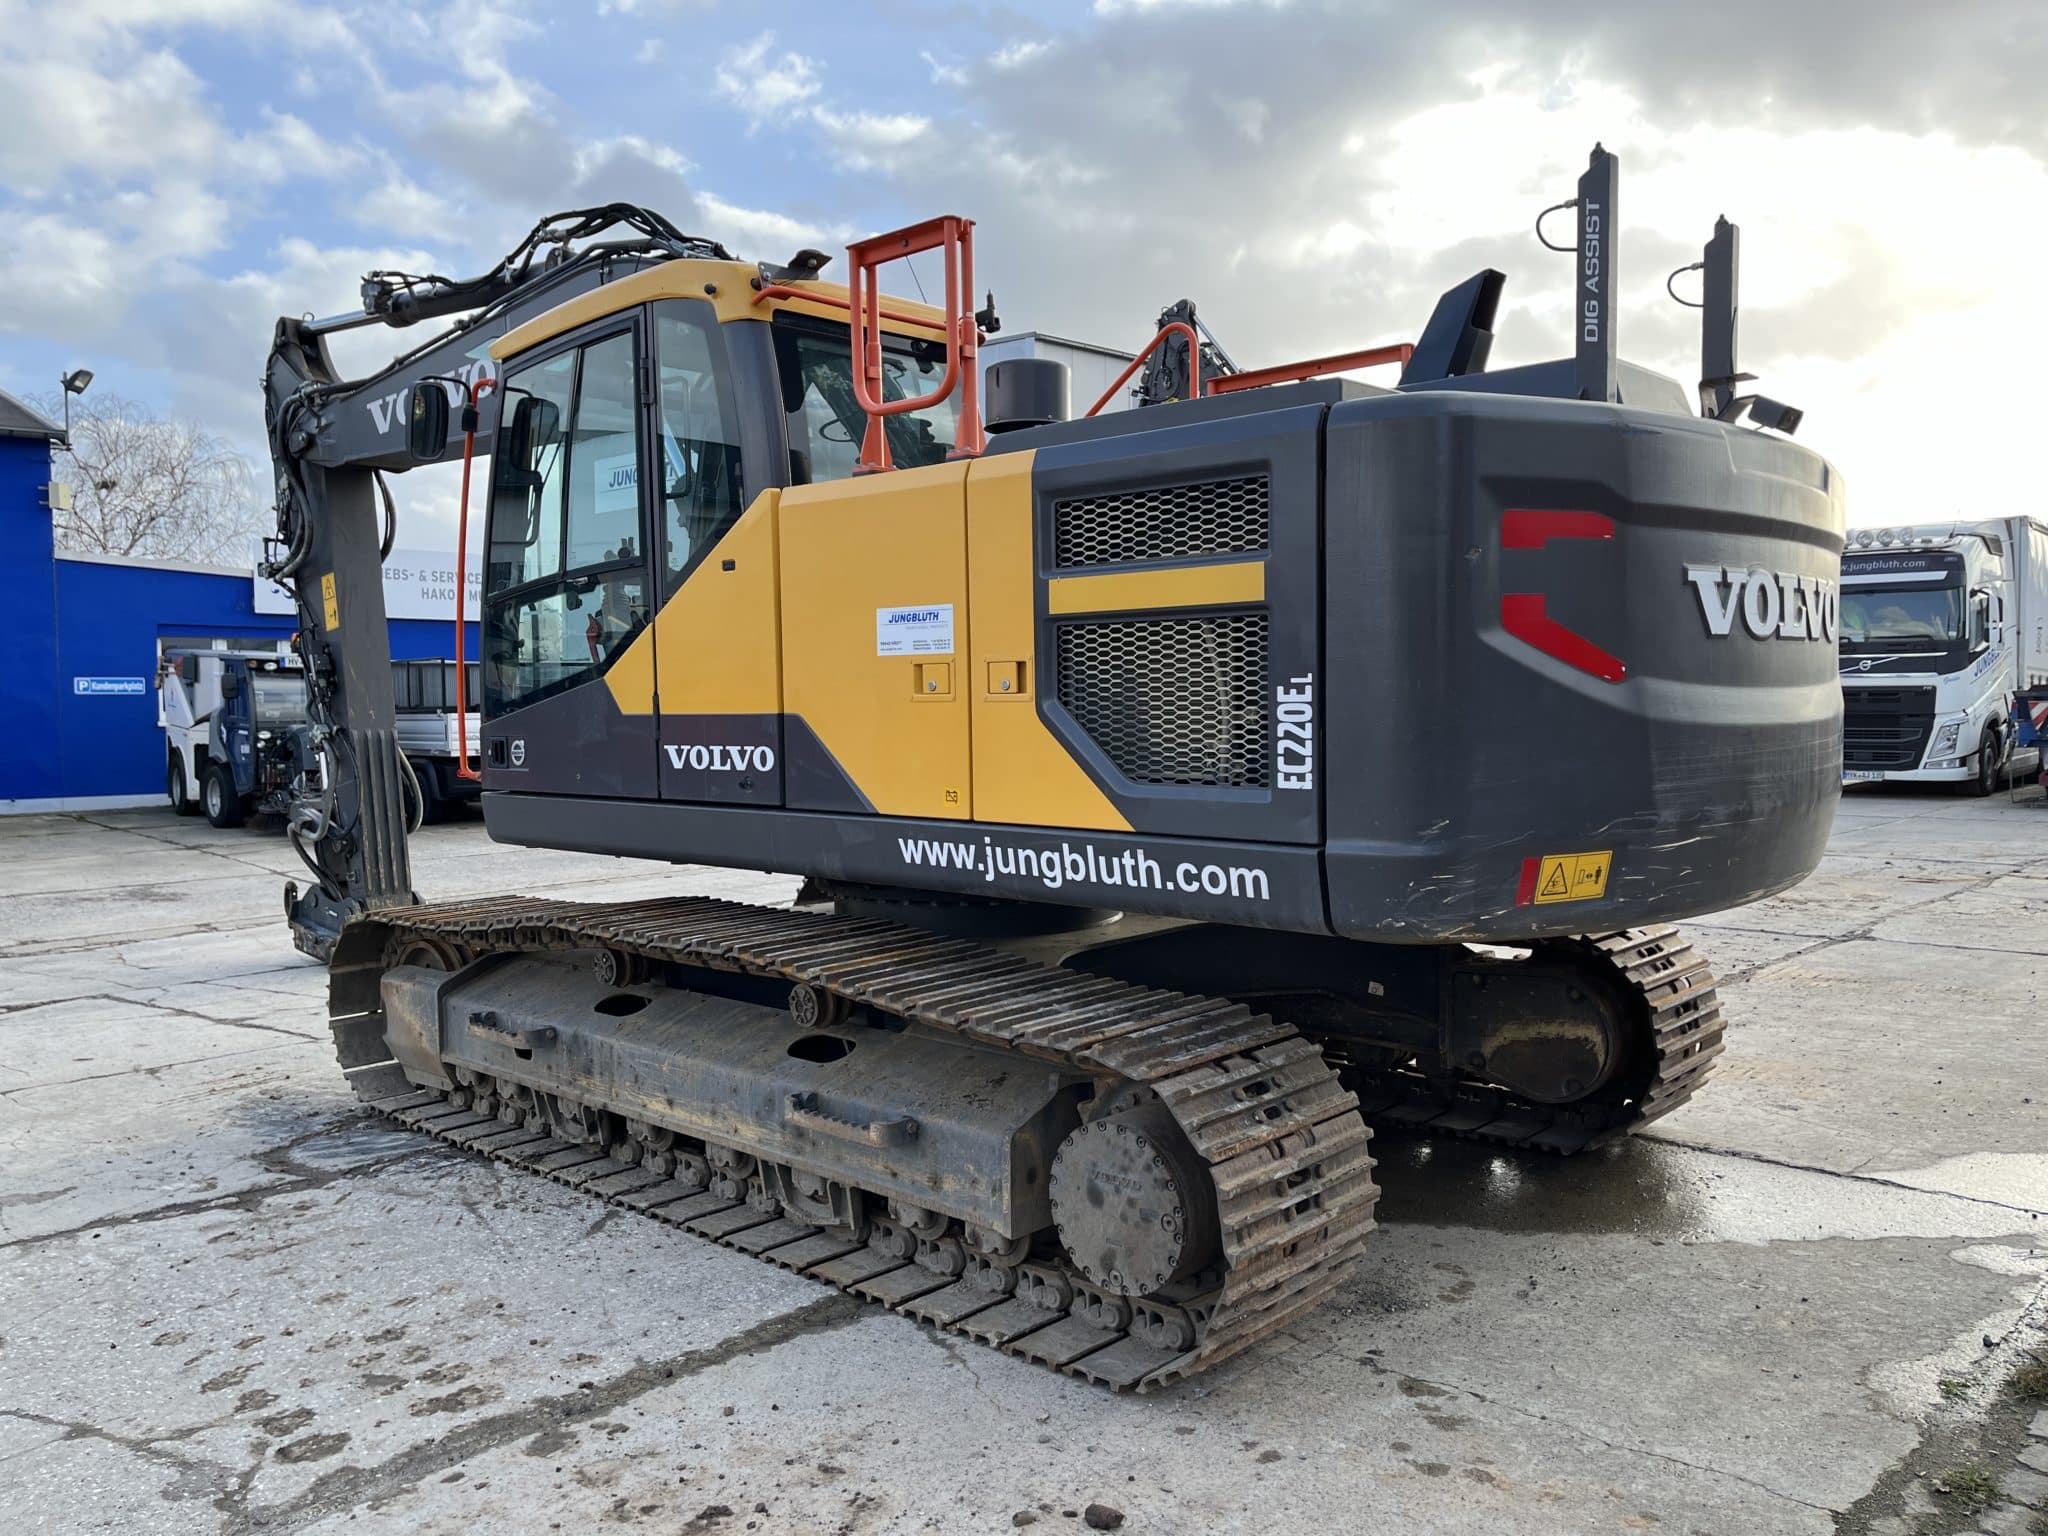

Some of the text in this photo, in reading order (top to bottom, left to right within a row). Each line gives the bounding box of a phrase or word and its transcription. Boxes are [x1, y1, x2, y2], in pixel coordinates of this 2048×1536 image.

[1584, 198, 1600, 342] DIG ASSIST
[366, 360, 496, 435] VVO
[421, 587, 456, 600] HAKO
[431, 571, 482, 585] SERCE
[888, 612, 940, 624] JUNGBLUTH
[1684, 563, 1838, 643] VOLVO
[663, 745, 775, 772] VOLVO
[898, 836, 1271, 900] www.jungbluth.com
